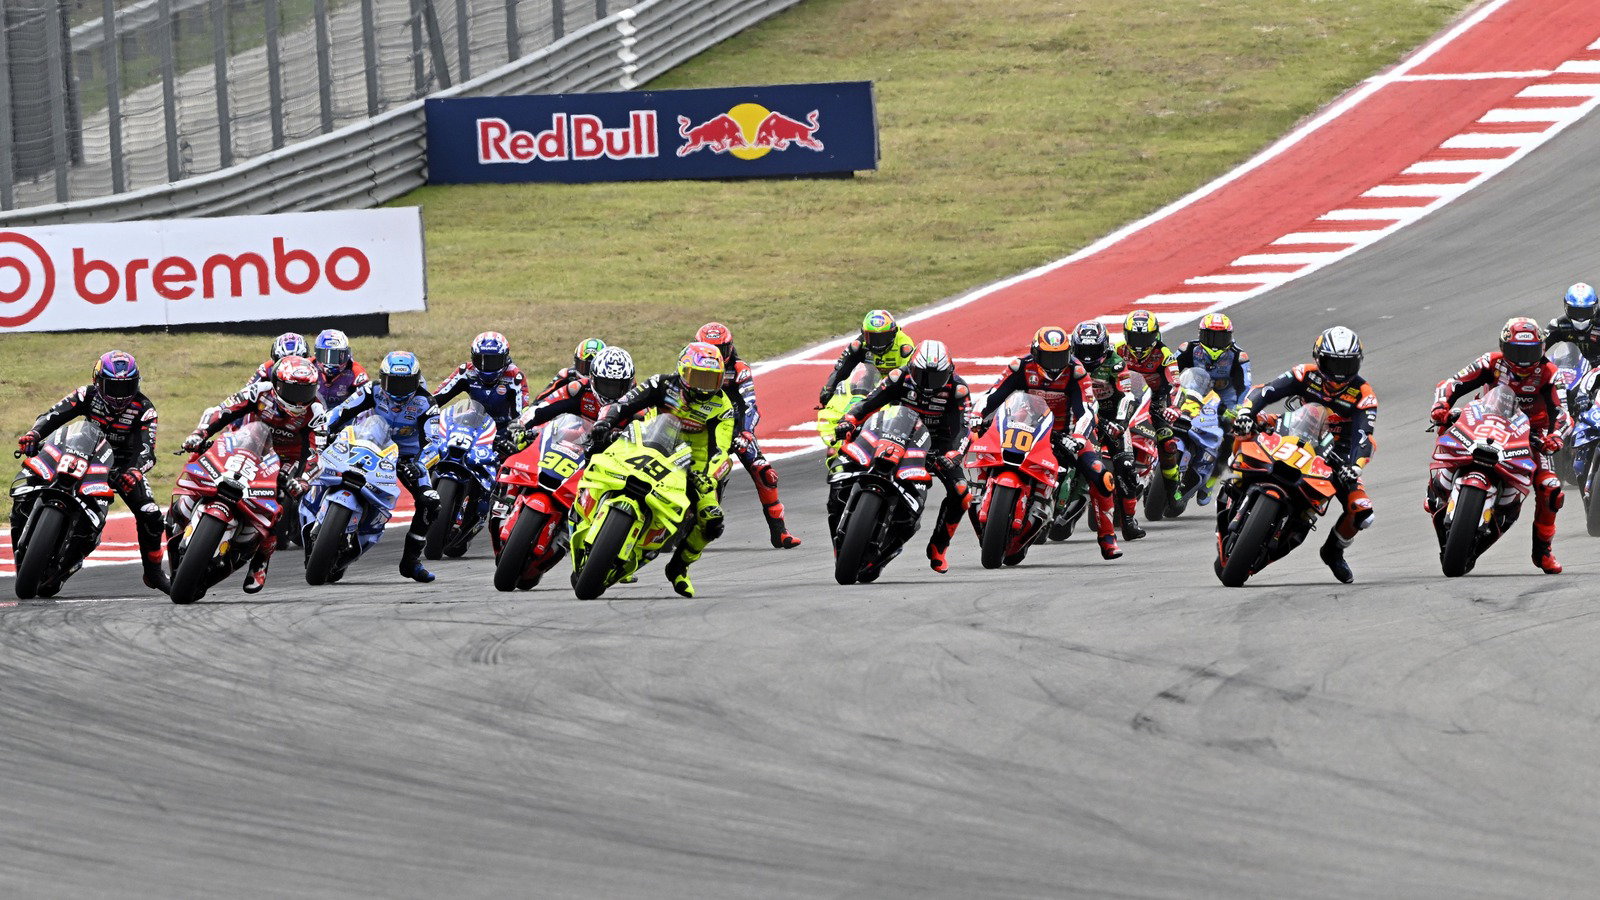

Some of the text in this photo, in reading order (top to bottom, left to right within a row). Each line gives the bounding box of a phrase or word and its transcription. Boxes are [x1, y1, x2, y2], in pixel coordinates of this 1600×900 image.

[72, 237, 371, 305] brembo
[1002, 428, 1034, 452] 10
[1450, 427, 1471, 447] Lenovo
[345, 446, 381, 472] 73
[538, 451, 580, 478] 36
[1503, 449, 1530, 458] Lenovo
[56, 454, 89, 478] 89
[199, 456, 219, 479] Lenovo
[624, 454, 672, 482] 49
